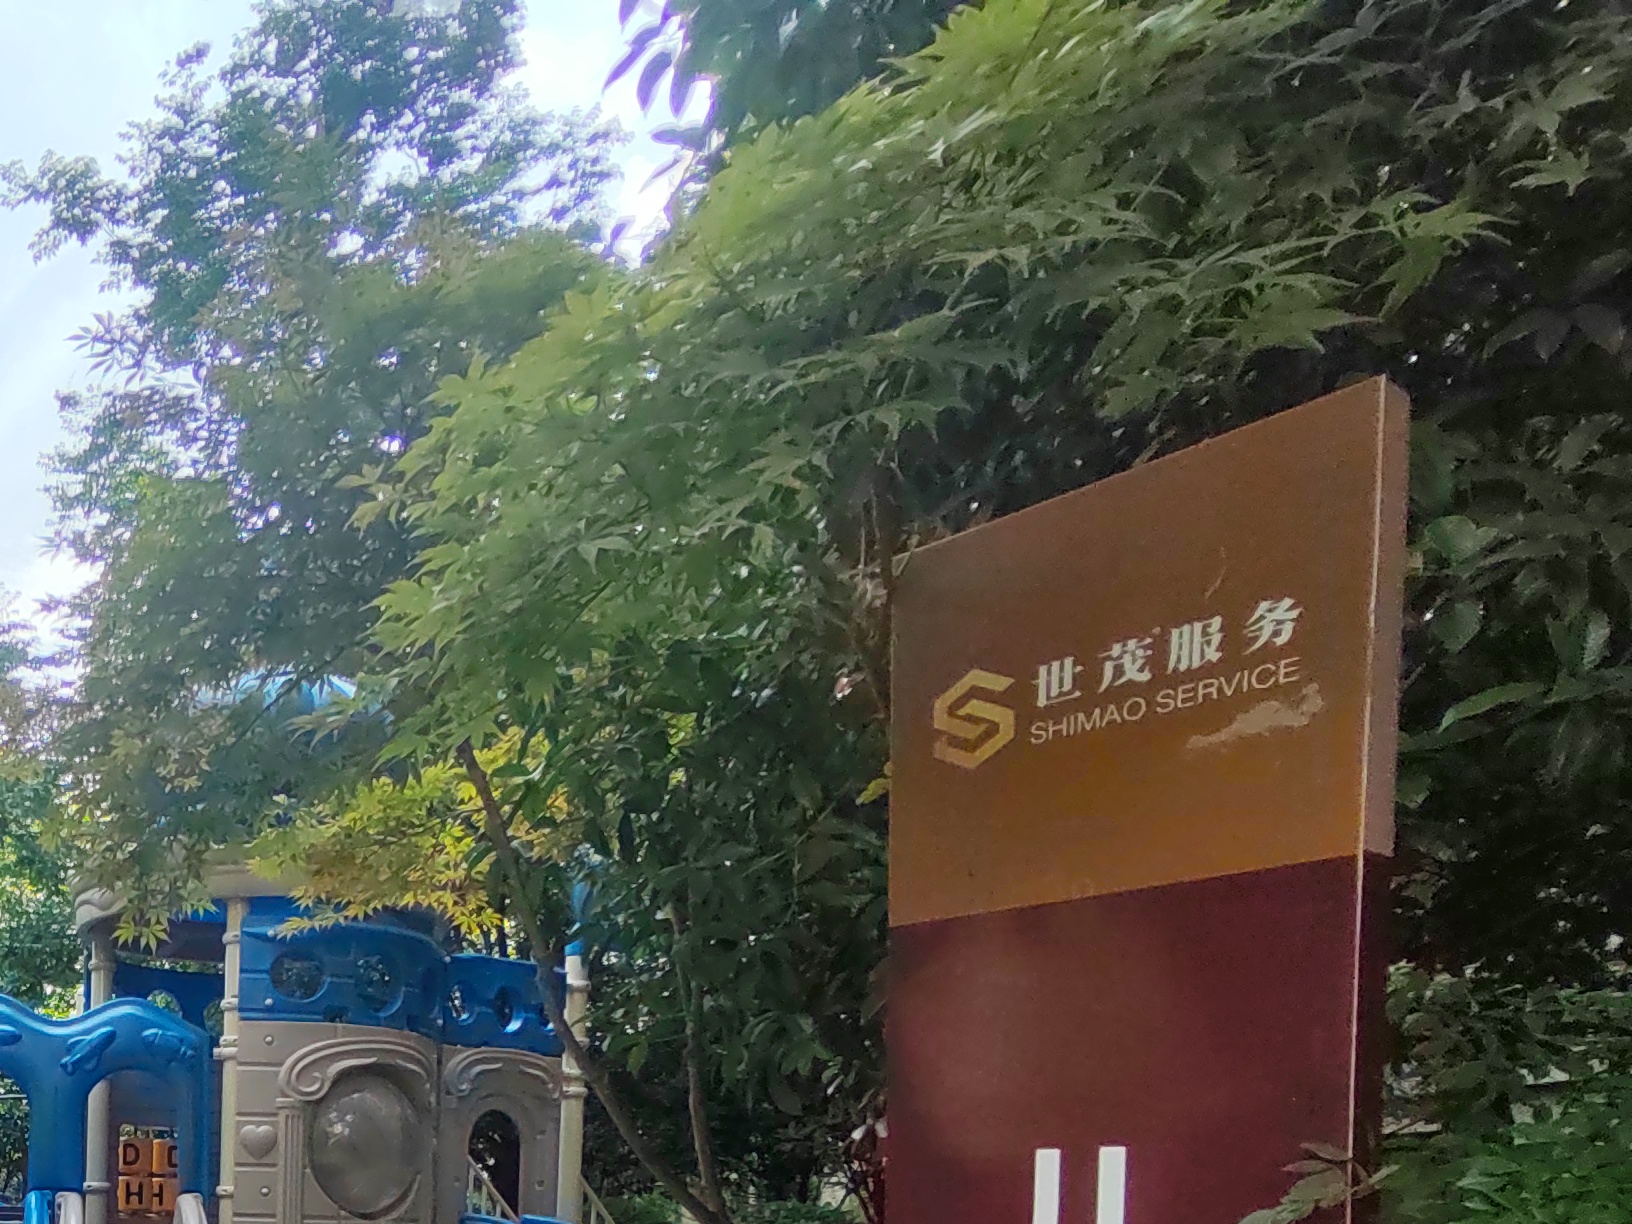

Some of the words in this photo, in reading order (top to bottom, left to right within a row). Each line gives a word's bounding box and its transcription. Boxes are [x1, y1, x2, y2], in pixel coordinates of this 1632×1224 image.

[1032, 596, 1304, 708] 世茂服务
[1029, 697, 1147, 745] SHIMAO
[1155, 656, 1301, 714] SERVICE
[125, 1181, 144, 1206] H
